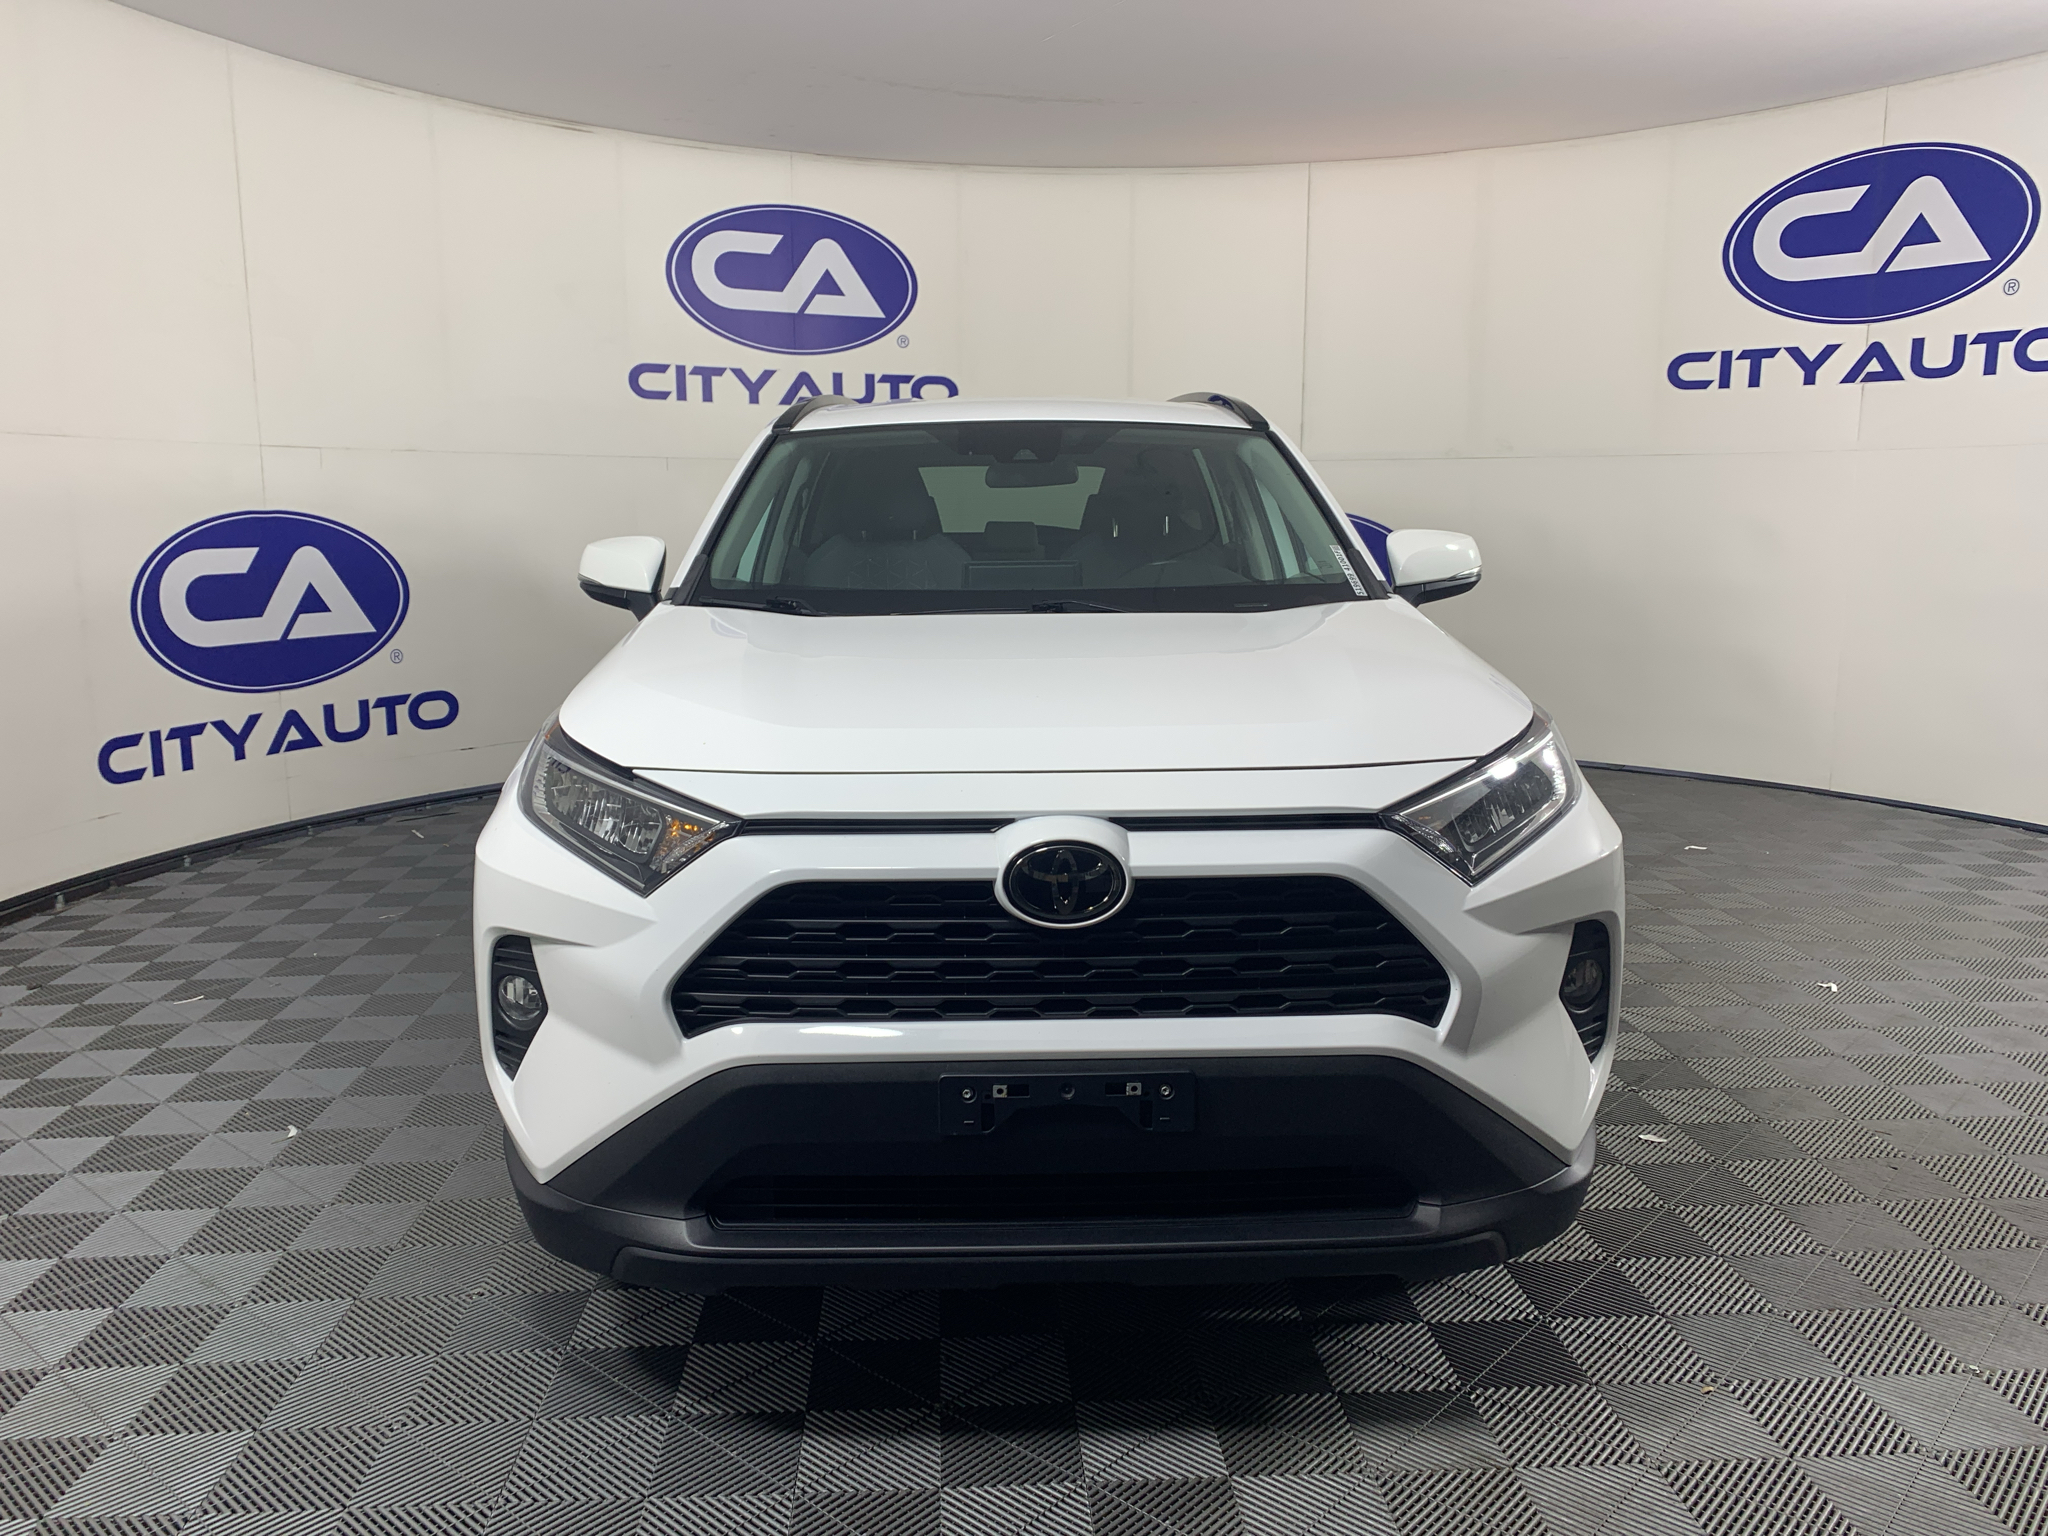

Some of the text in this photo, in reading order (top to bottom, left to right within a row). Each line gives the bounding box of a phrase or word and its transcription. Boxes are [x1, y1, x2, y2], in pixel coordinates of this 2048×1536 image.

[691, 230, 887, 319] CA
[1752, 174, 1993, 283] CA
[158, 545, 378, 648] CA
